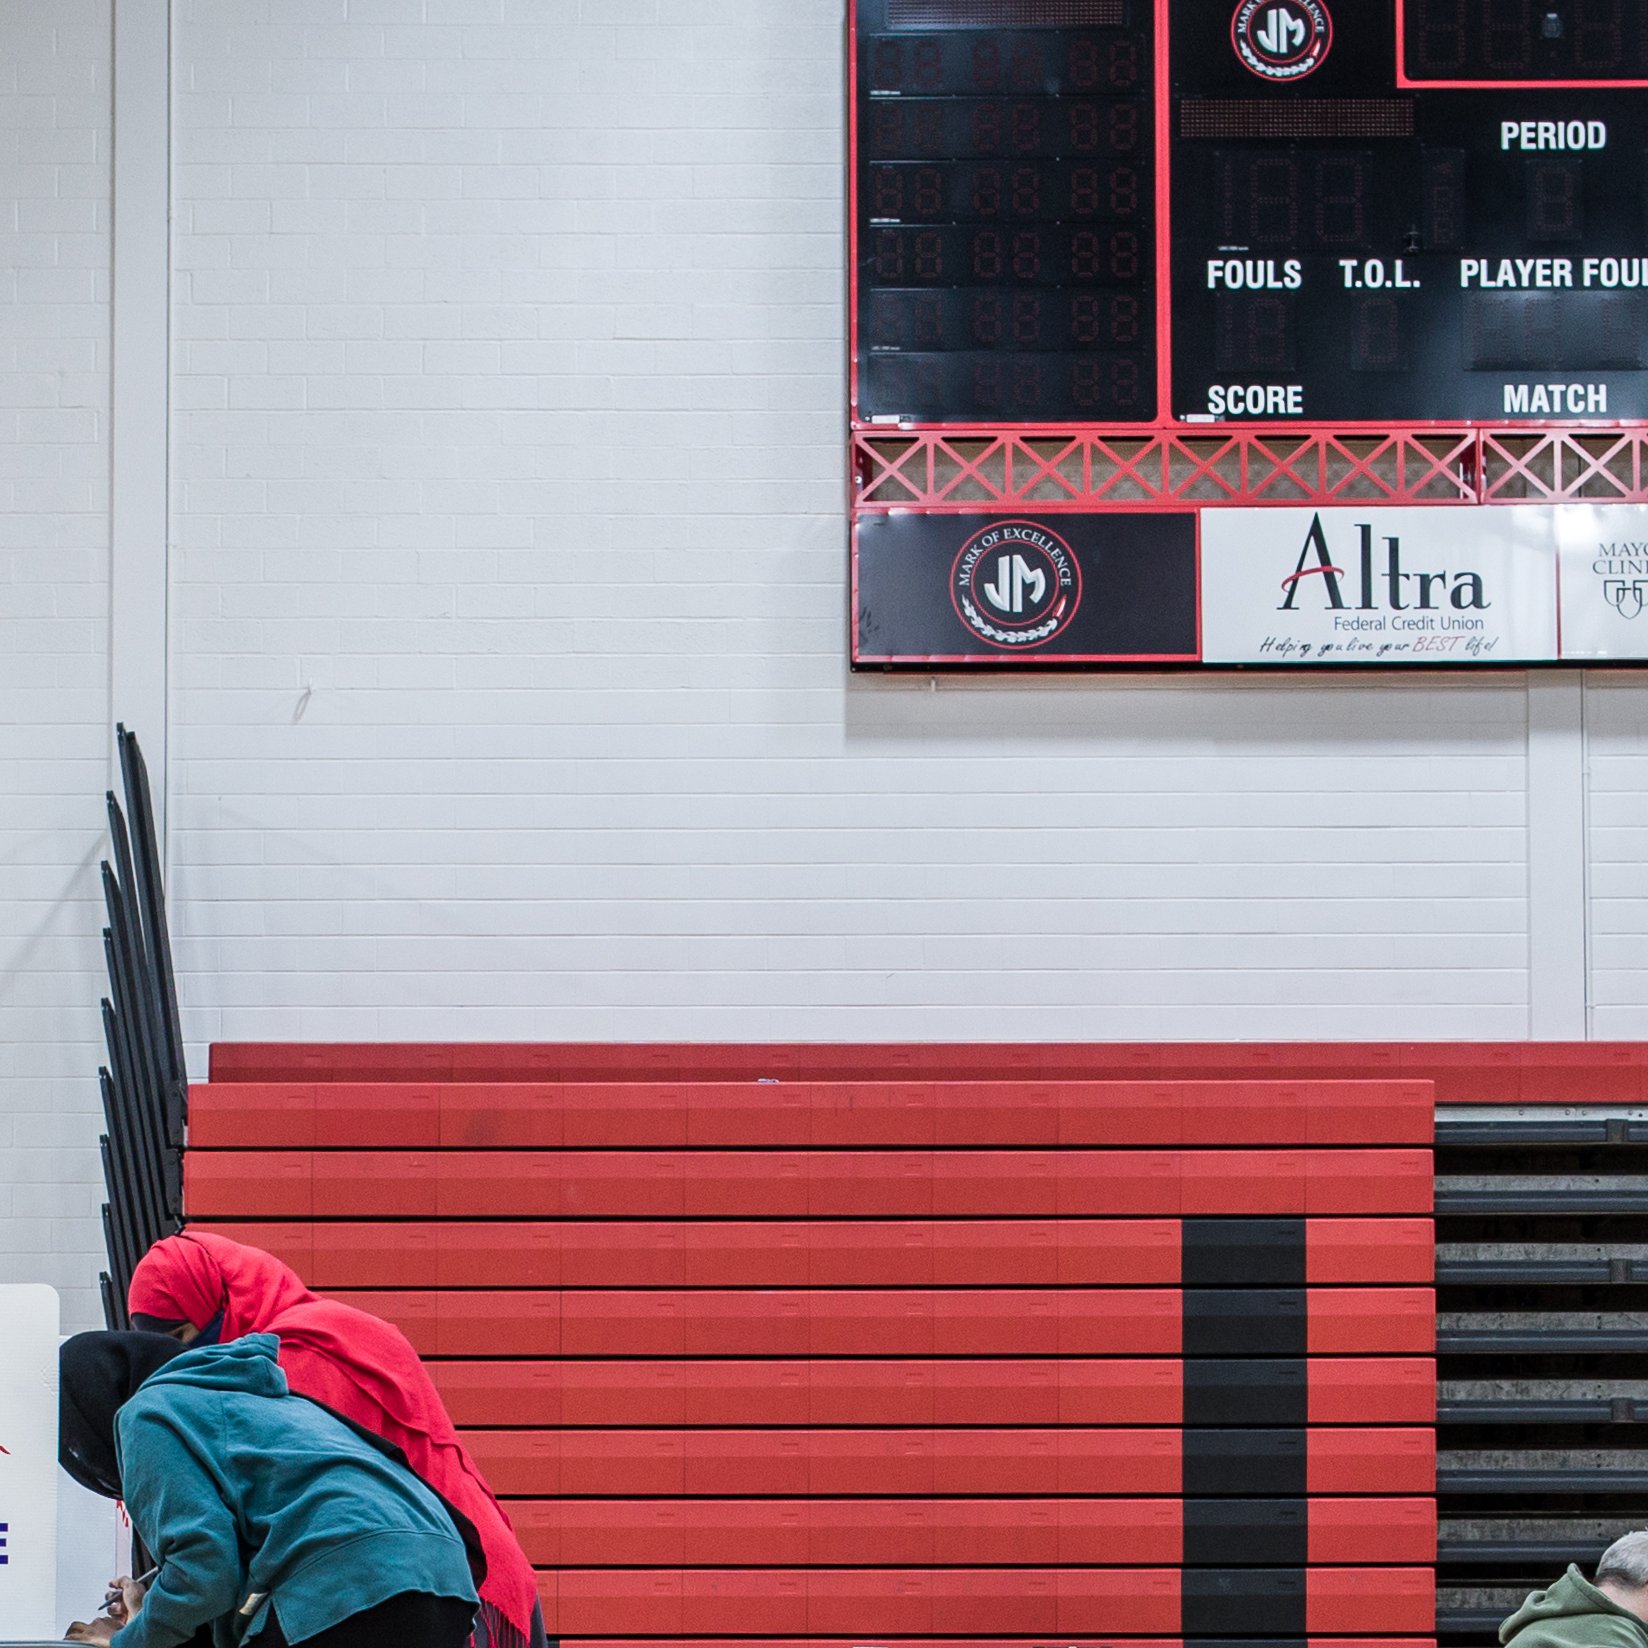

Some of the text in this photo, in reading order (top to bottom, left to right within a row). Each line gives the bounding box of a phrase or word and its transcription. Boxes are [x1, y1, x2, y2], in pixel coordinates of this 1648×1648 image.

[1257, 8, 1306, 54] JM
[1501, 121, 1607, 150] PERIOD
[1207, 259, 1302, 289] FOULS
[1339, 259, 1421, 288] T.O.L.
[1460, 258, 1573, 288] PLAYER
[1208, 385, 1303, 414] SCORE
[1504, 384, 1607, 413] MATCH
[958, 527, 1072, 587] MARK OF EXCELLENCE
[1276, 511, 1492, 610] Altra
[983, 554, 1046, 613] JM
[1334, 616, 1485, 631] Federal Credit Union
[1259, 636, 1313, 658] Helping
[1317, 641, 1343, 658] you
[1346, 637, 1374, 652] live
[1376, 642, 1411, 657] your
[1412, 635, 1467, 653] BEST
